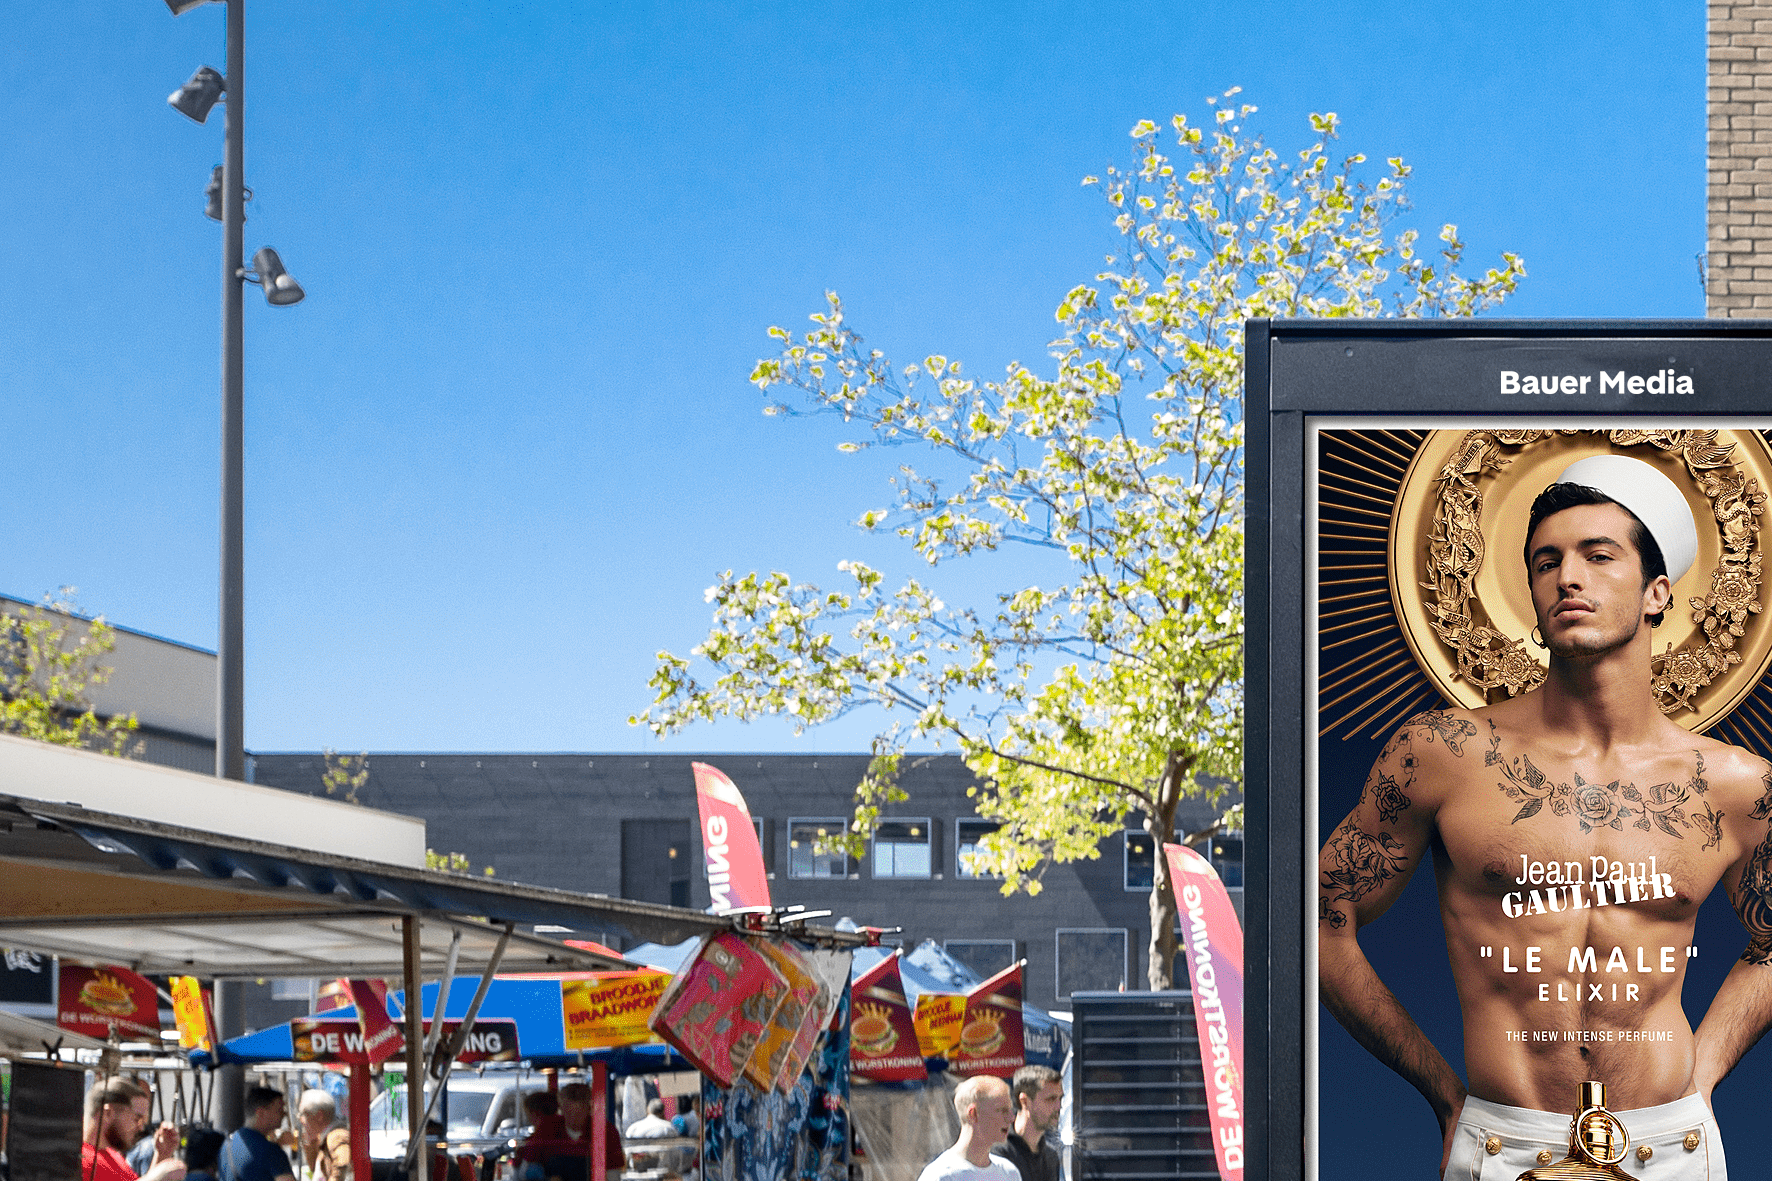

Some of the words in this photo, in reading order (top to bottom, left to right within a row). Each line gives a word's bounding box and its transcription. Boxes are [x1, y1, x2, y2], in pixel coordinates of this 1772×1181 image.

[1500, 370, 1592, 395] Bauer
[1599, 369, 1695, 395] Media
[1515, 854, 1585, 885] Jean
[1501, 872, 1677, 919] GAULTIER
[1538, 983, 1640, 1001] ELIXIR
[1505, 1030, 1528, 1042] THE
[1533, 1030, 1559, 1042] NEW
[1563, 1030, 1614, 1042] INTENSE
[1618, 1030, 1674, 1042] PERFUME
